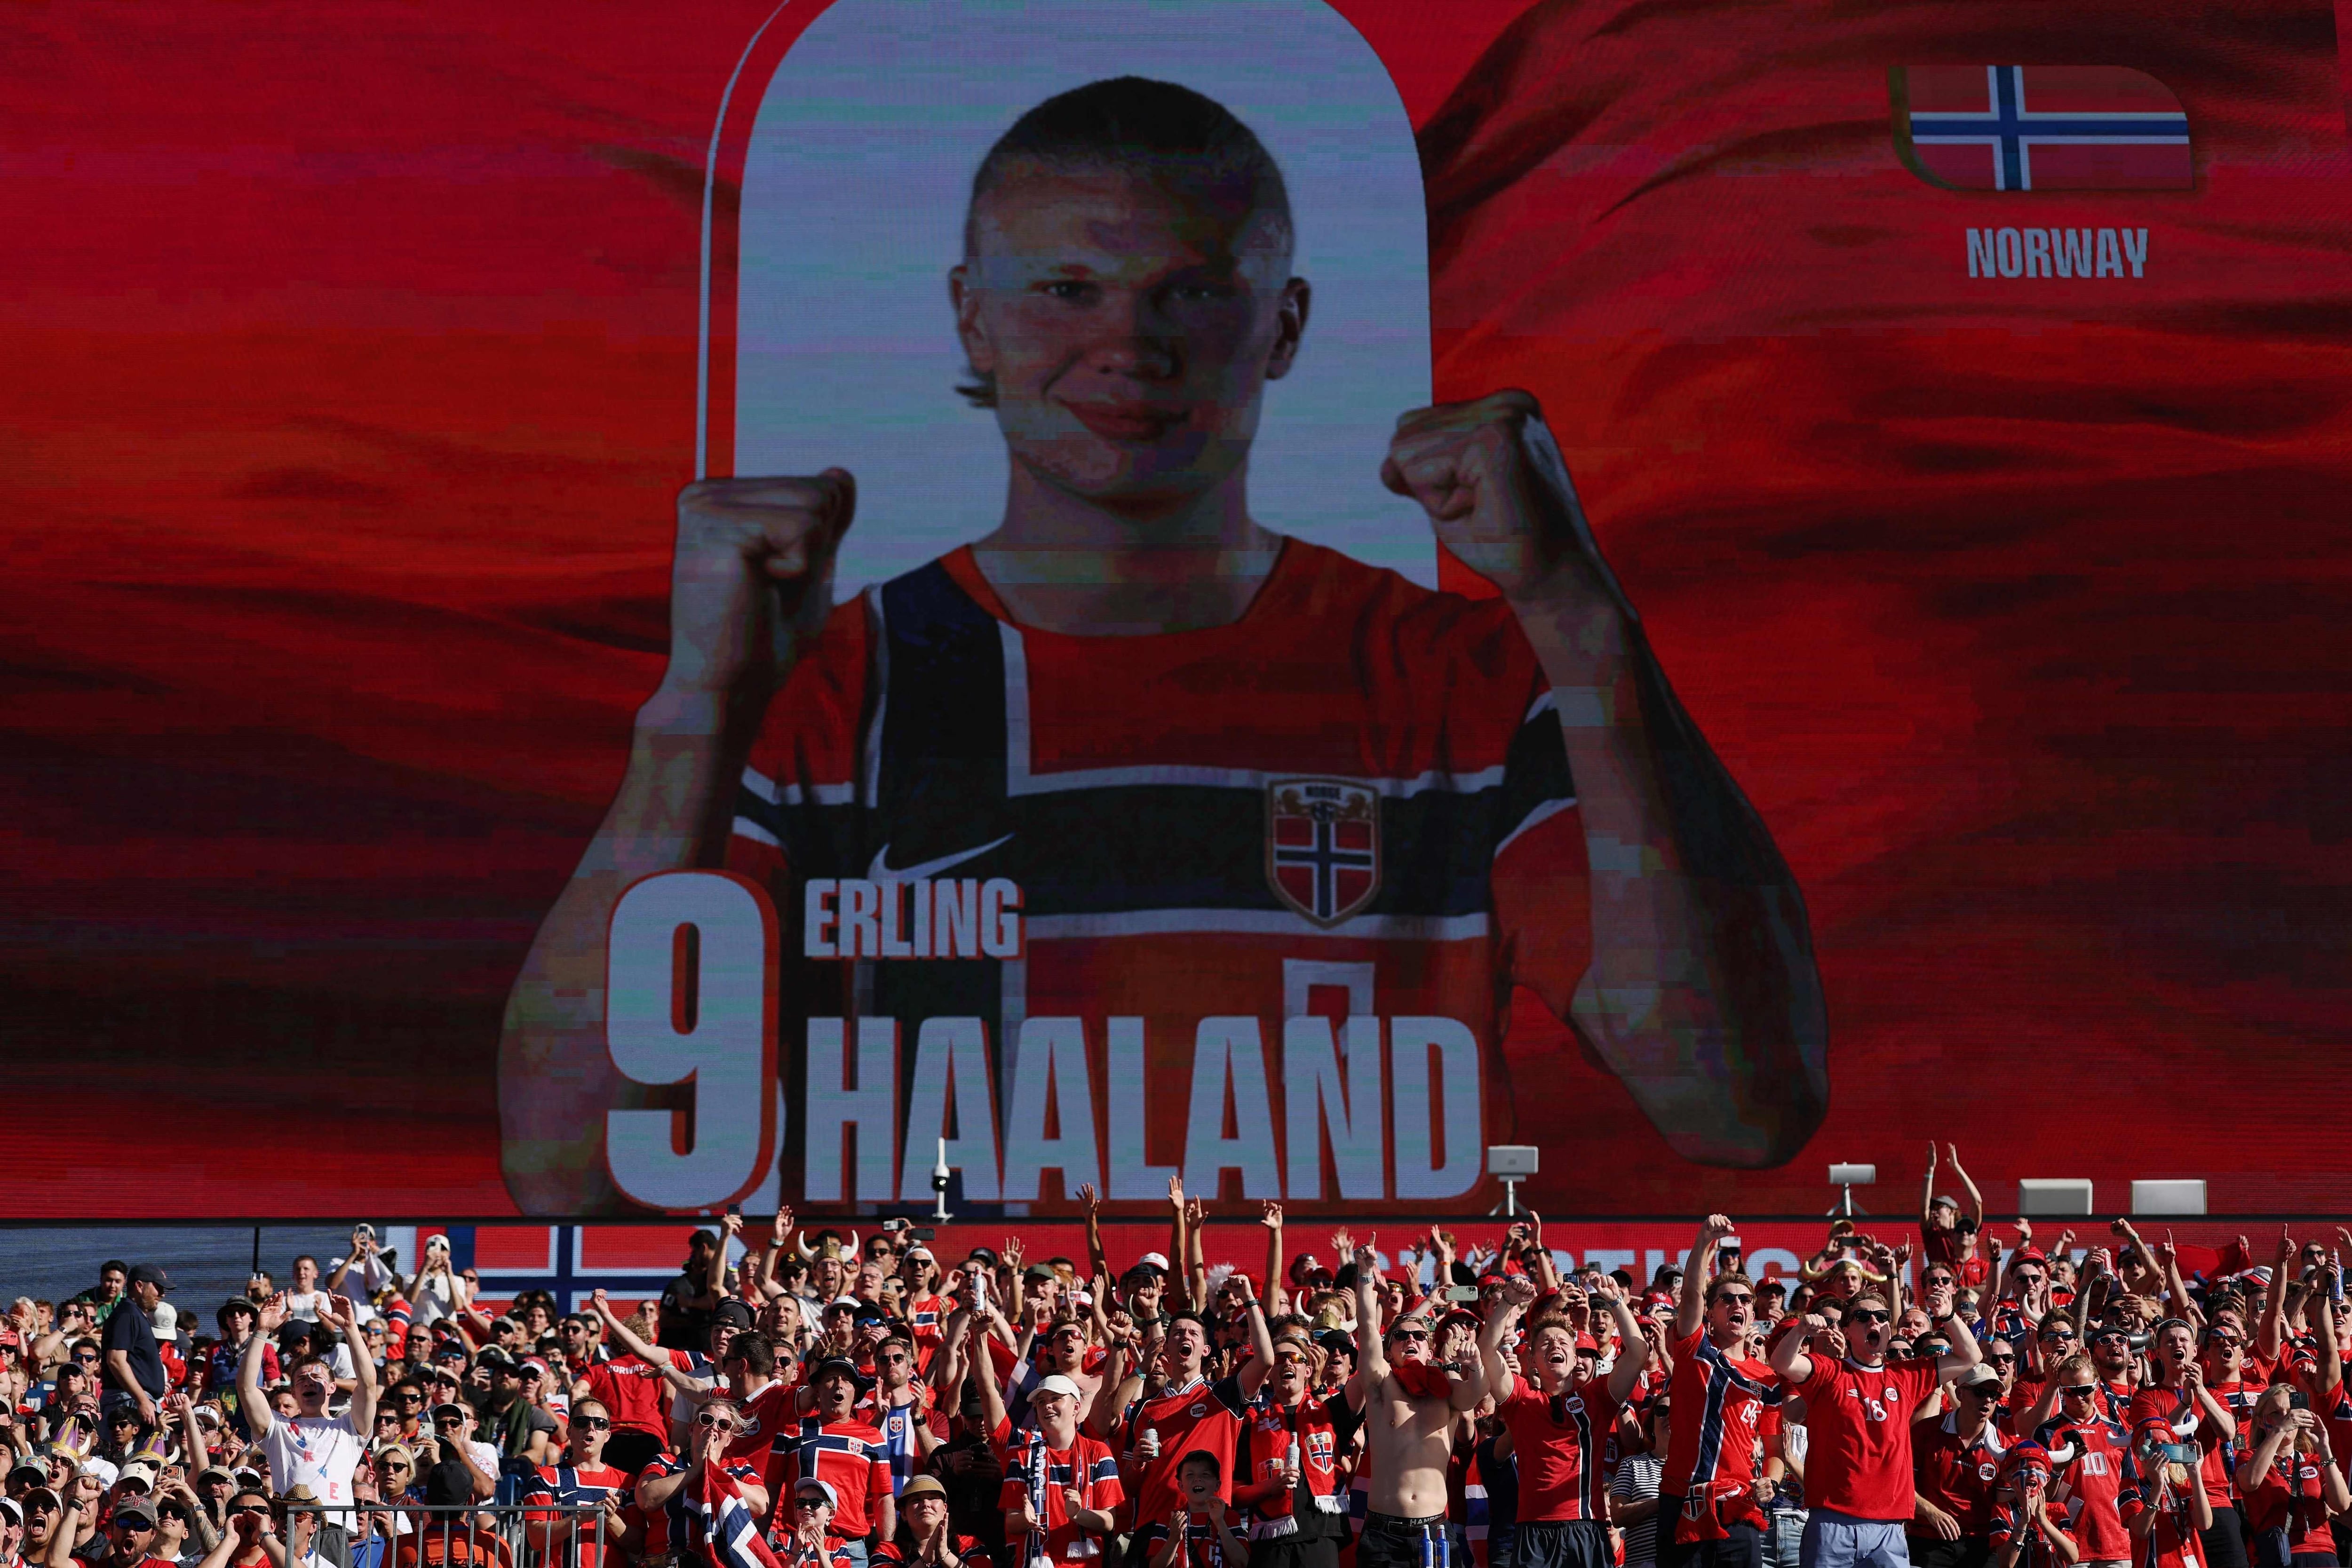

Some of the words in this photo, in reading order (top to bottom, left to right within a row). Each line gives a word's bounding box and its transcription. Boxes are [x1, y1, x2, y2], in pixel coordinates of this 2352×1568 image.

[1966, 227, 2148, 278] NORWAY
[805, 878, 1021, 958] ERLING
[605, 871, 768, 1208] 9
[805, 1015, 1482, 1202] HAALAND
[606, 1364, 646, 1375] NORWAY
[1863, 1396, 1888, 1422] 18
[1030, 1440, 1047, 1501] ORGE
[1952, 1459, 1973, 1468] UMBRO
[2082, 1451, 2108, 1476] 10
